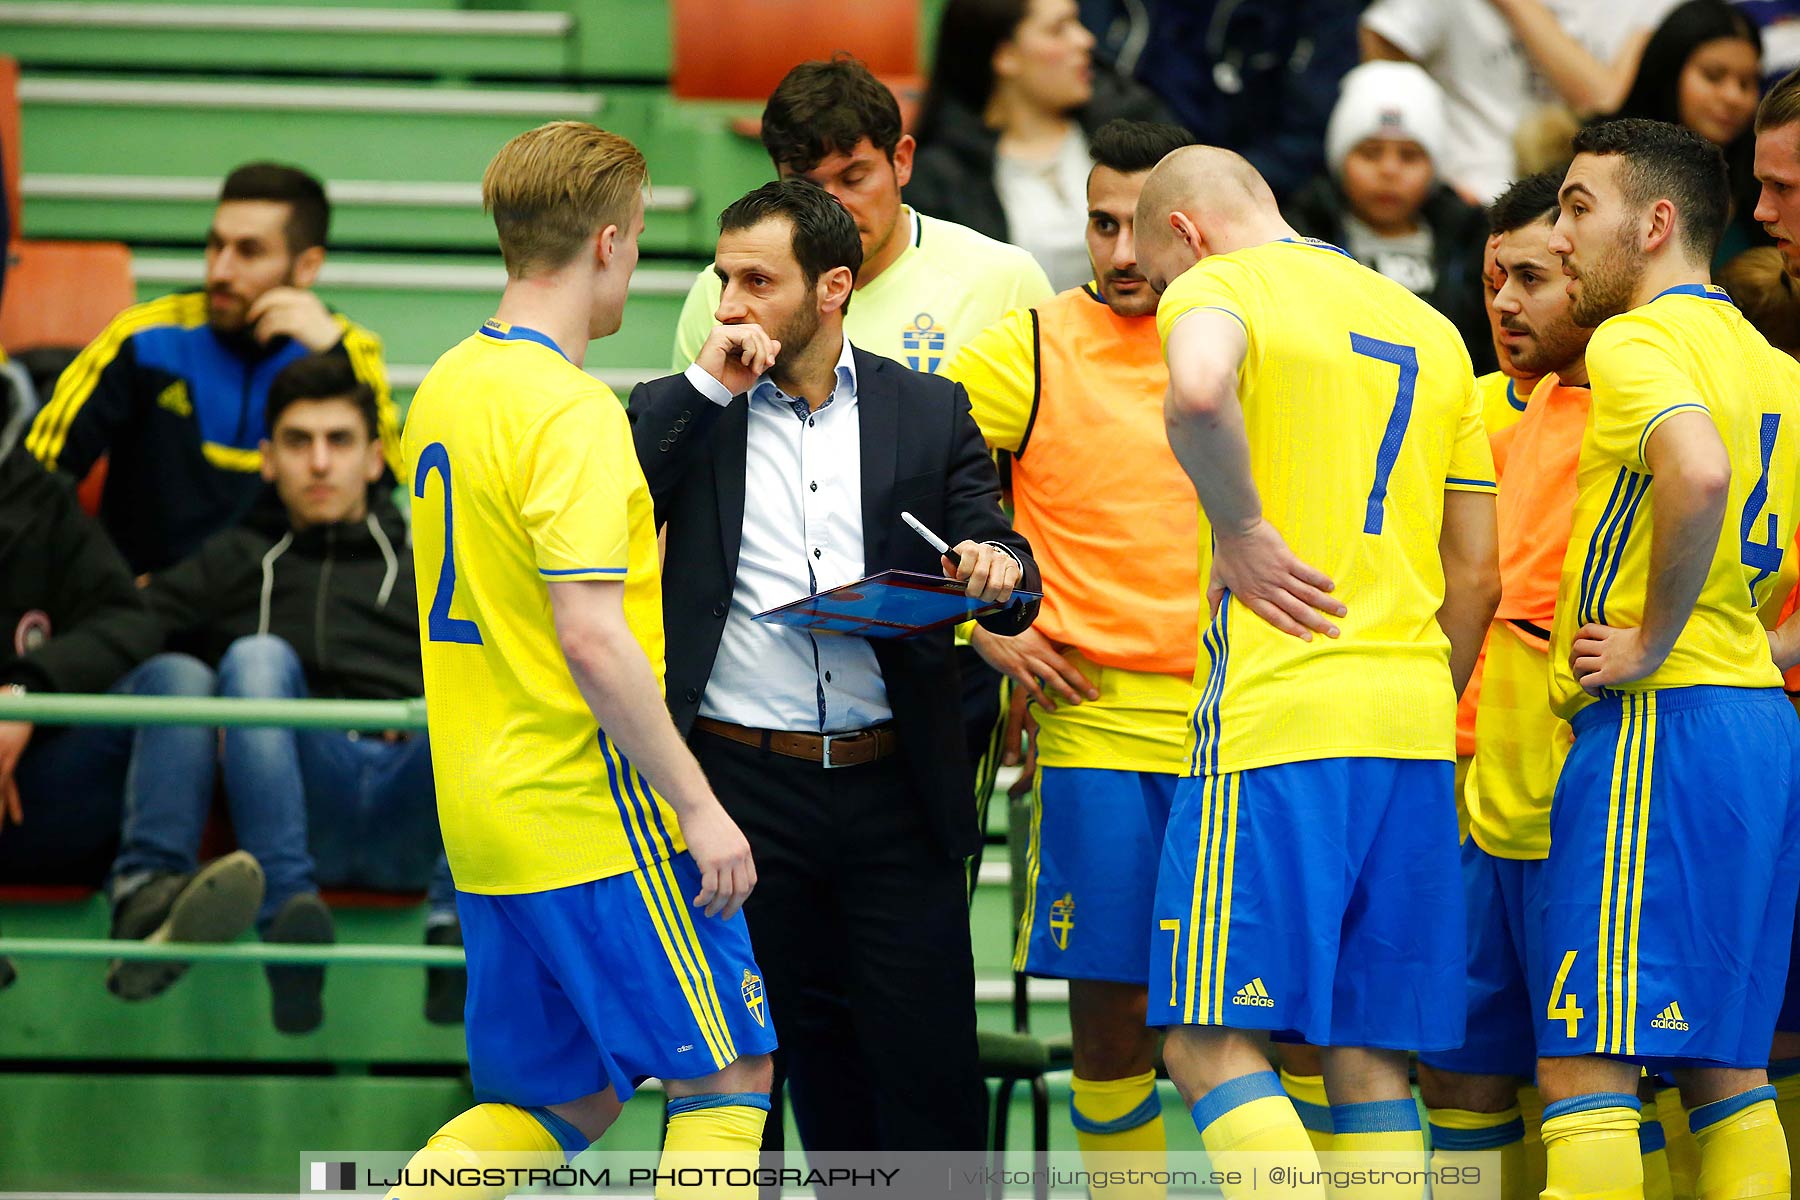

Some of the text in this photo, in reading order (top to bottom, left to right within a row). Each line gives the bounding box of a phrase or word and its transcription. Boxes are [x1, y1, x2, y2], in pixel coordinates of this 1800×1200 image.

[1349, 331, 1419, 535] 7
[415, 442, 484, 646] 2
[1741, 413, 1784, 608] 4
[1159, 919, 1180, 1007] 7
[1232, 995, 1275, 1008] adidas
[1547, 951, 1584, 1038] 4
[1650, 1018, 1689, 1031] adidas
